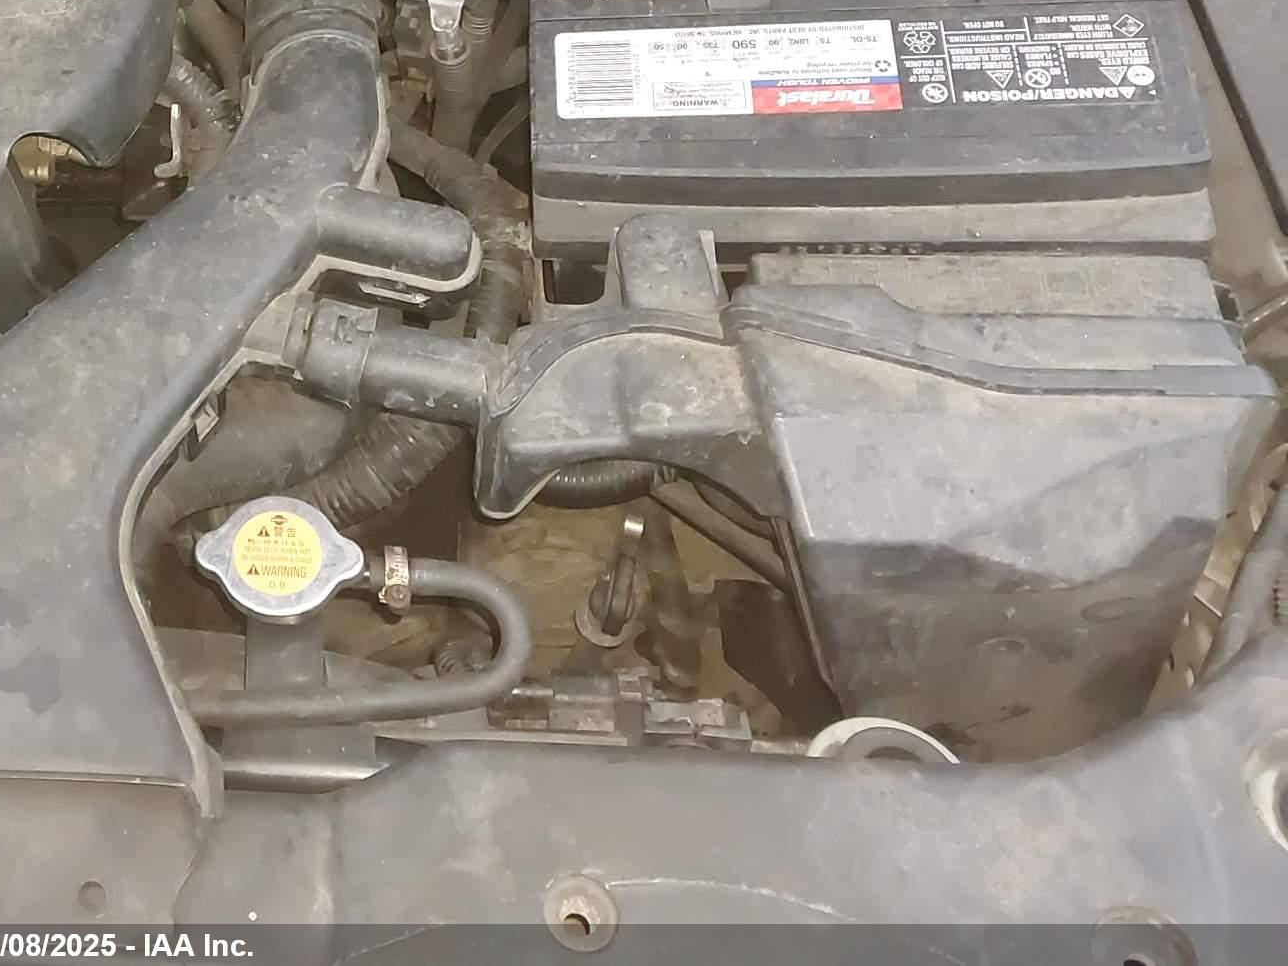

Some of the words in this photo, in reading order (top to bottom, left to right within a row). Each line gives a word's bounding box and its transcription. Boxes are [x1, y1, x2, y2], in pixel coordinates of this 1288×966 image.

[1004, 33, 1025, 41] READ
[731, 38, 756, 50] 590
[1080, 50, 1105, 58] GASES
[1106, 49, 1148, 58] EXPLOSIVE
[822, 76, 871, 86] PROVEN
[775, 88, 876, 107] Duralast
[963, 87, 1120, 102] DANGER/POISON
[262, 564, 307, 578] WARNING
